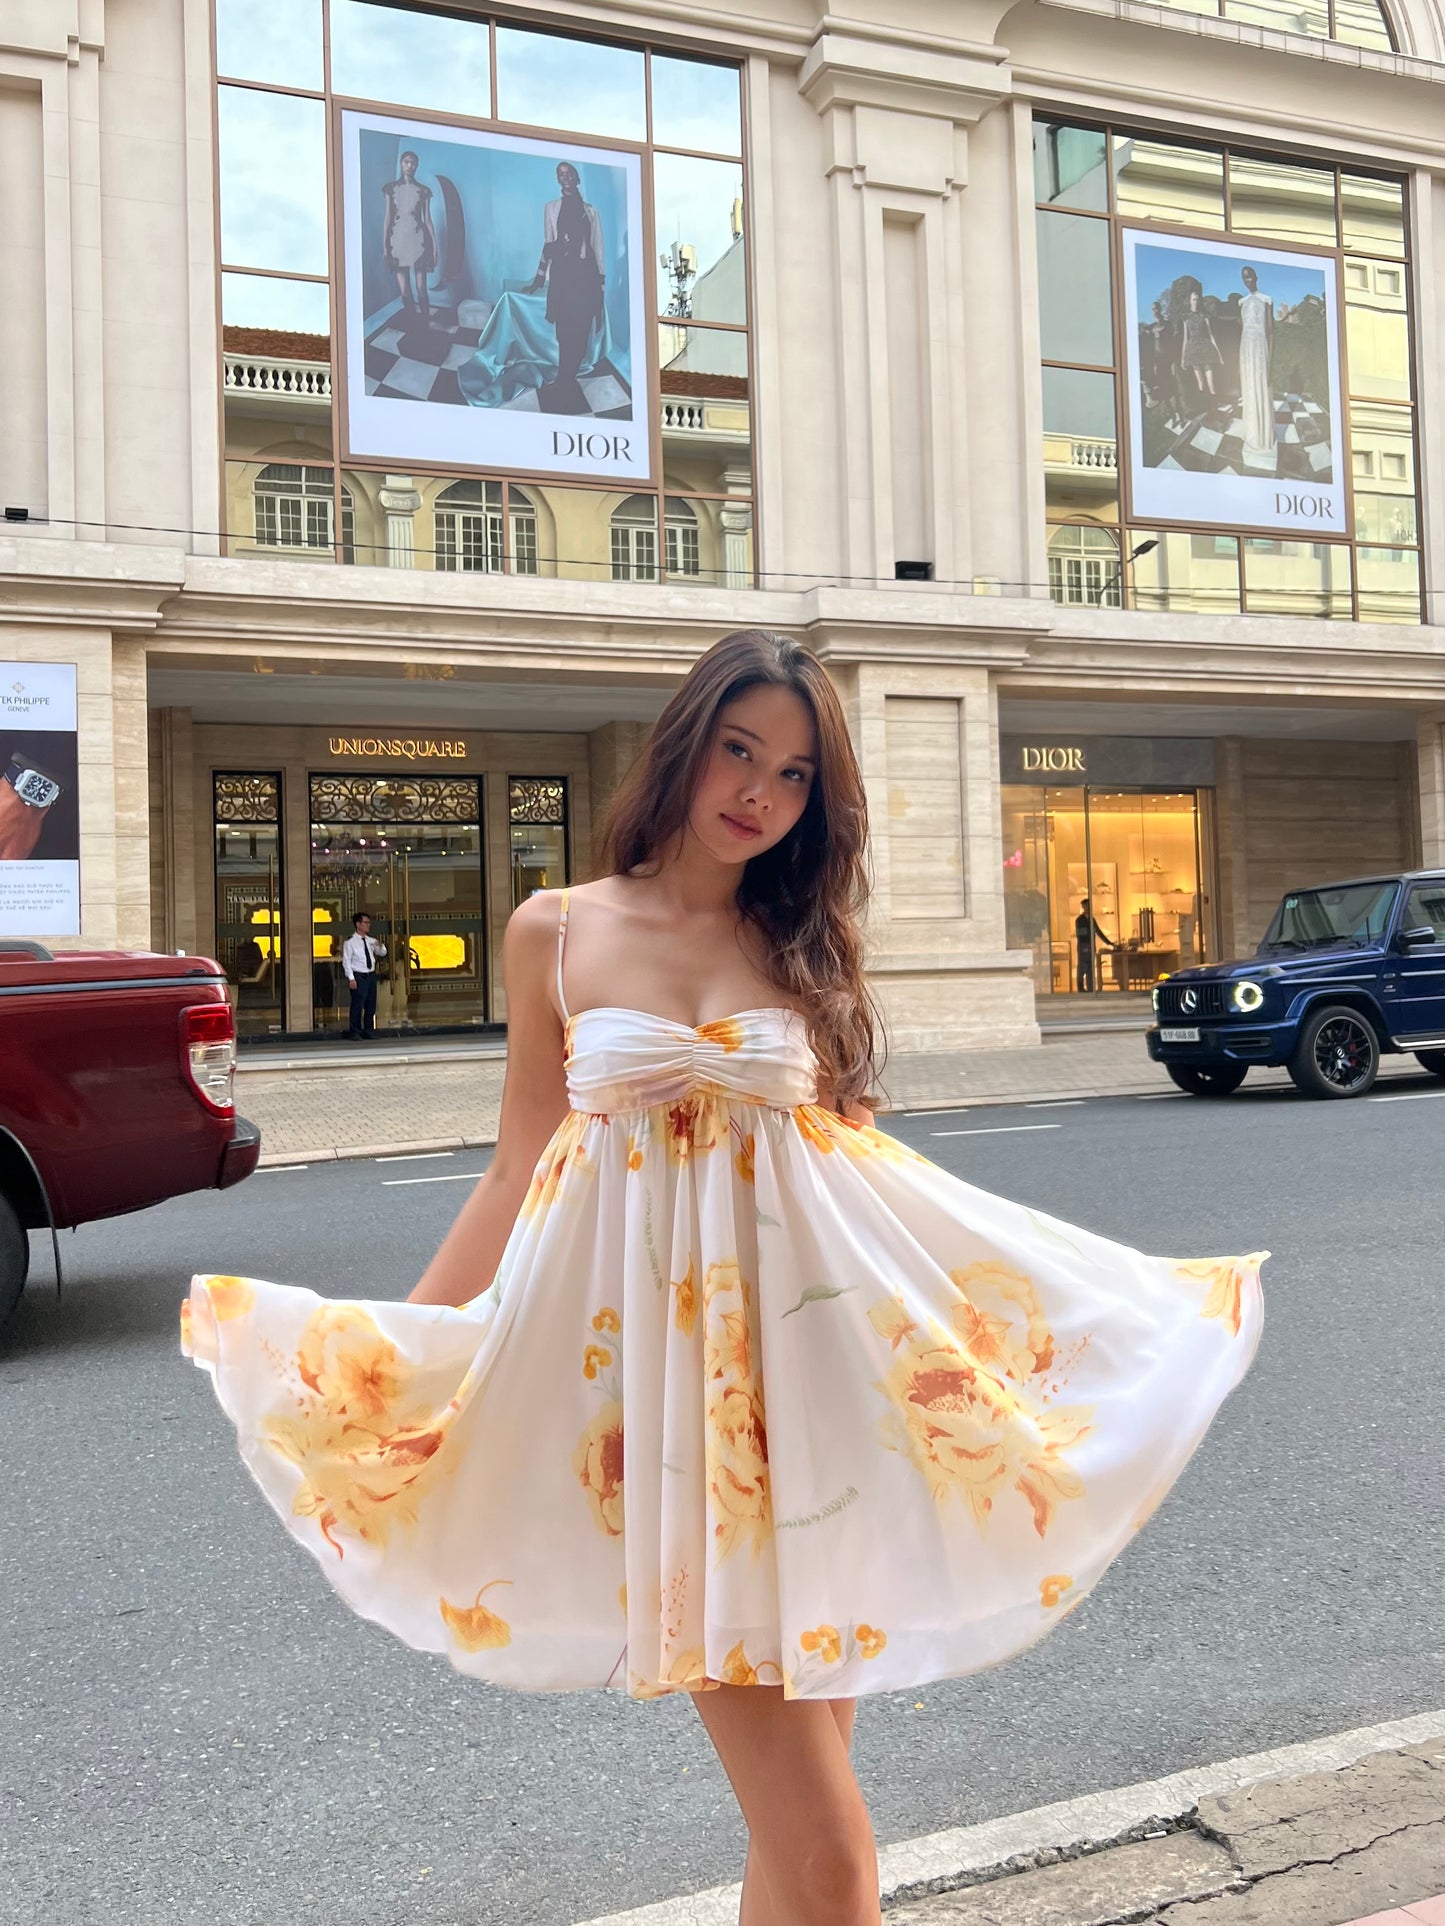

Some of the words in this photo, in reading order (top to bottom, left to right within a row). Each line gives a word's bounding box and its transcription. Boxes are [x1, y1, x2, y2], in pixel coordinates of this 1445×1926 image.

[551, 431, 634, 462] DIOR
[1273, 493, 1334, 519] DIOR
[0, 696, 12, 705] EK
[14, 697, 50, 705] PHILIPPE
[329, 738, 466, 759] UNIONSQUARE
[1023, 747, 1086, 771] DIOR
